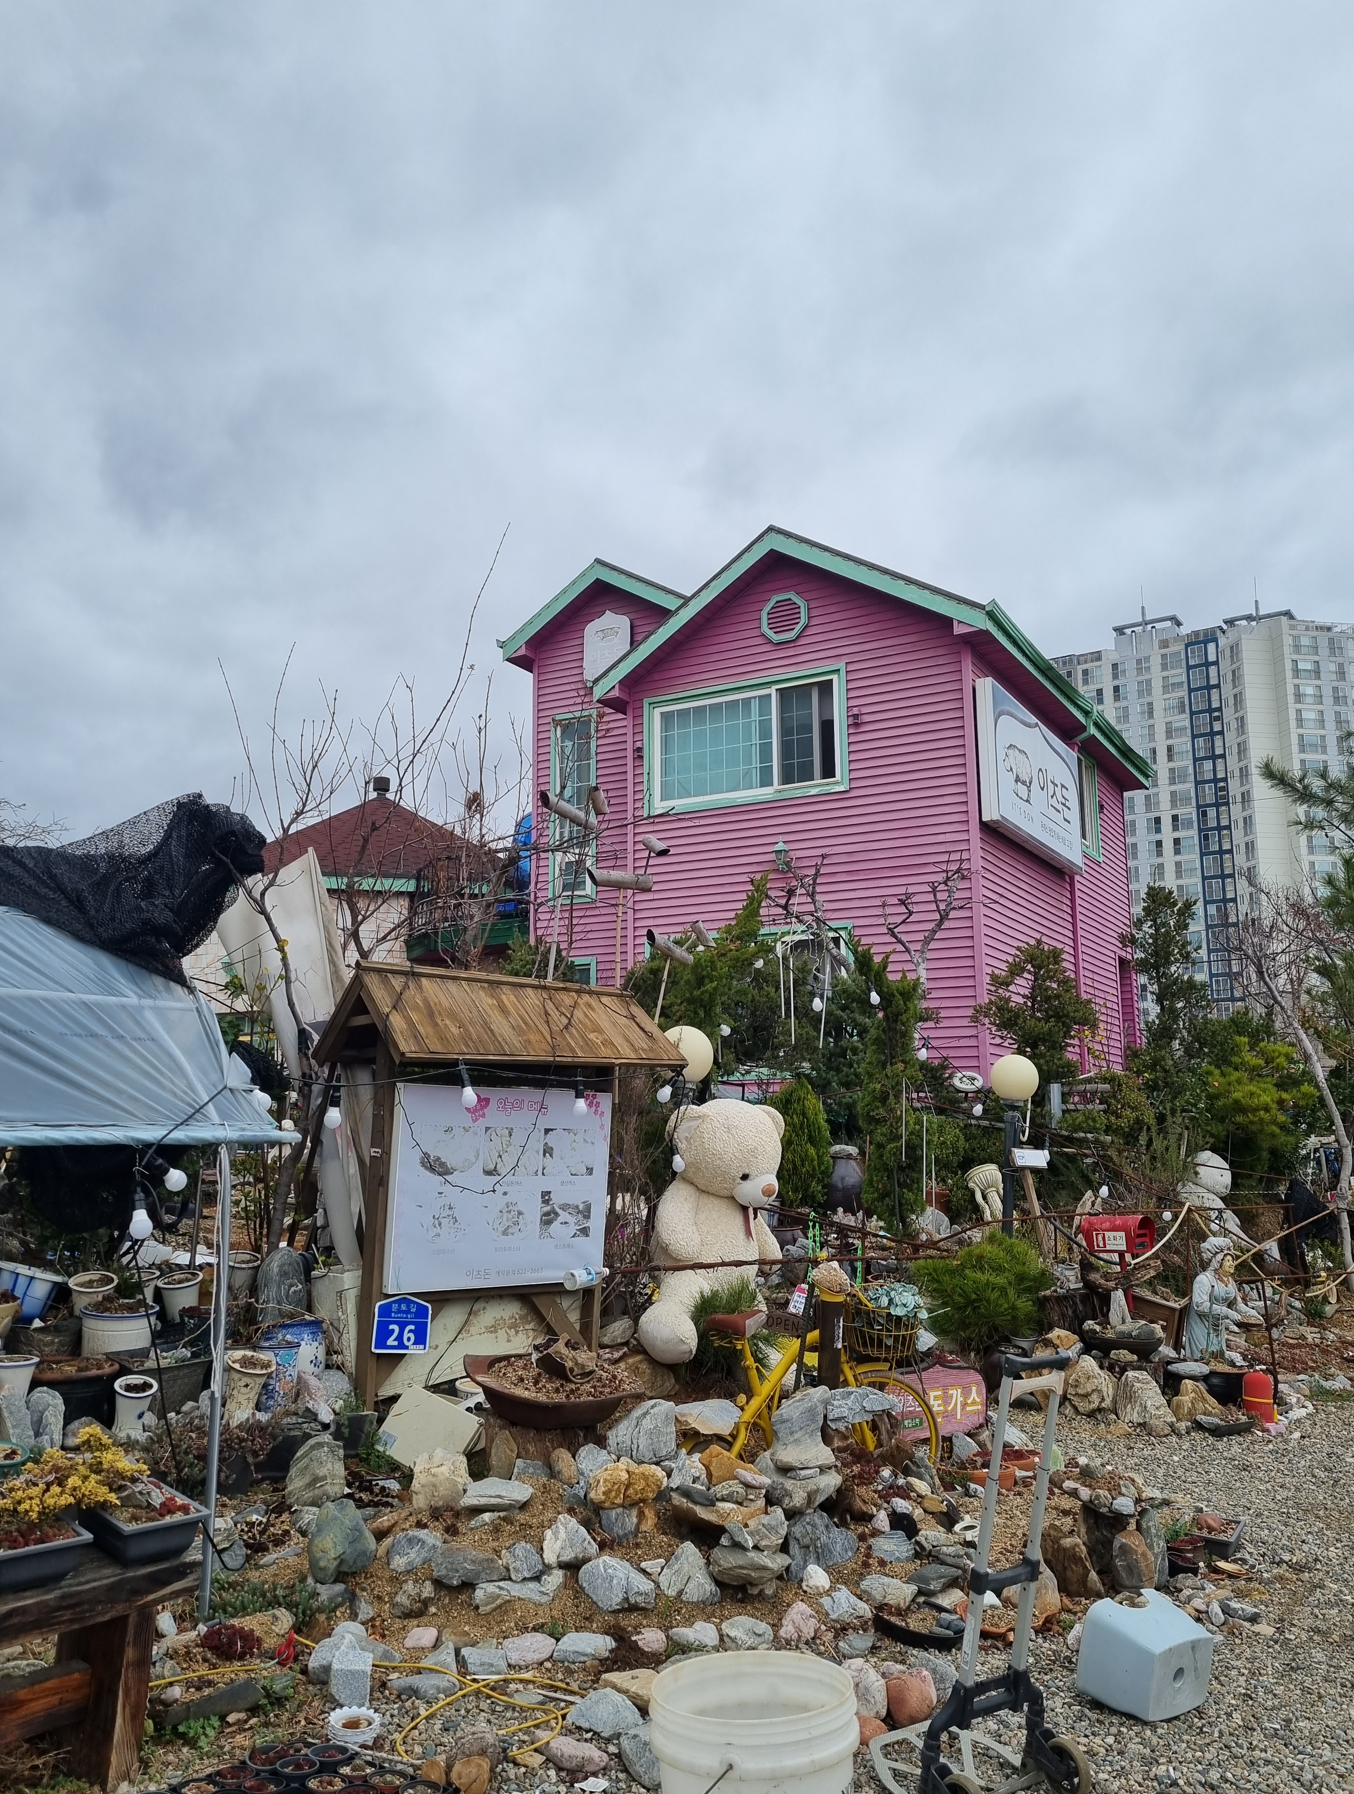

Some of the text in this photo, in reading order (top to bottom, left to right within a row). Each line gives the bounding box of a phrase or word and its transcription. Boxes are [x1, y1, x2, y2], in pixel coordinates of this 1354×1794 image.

[1037, 767, 1072, 825] 이츠돈
[496, 1097, 549, 1116] 오늘의 메뉴
[465, 1268, 491, 1281] 이츠돈
[391, 1303, 417, 1313] 분토길
[766, 1315, 800, 1333] OPEN
[386, 1324, 416, 1346] 26
